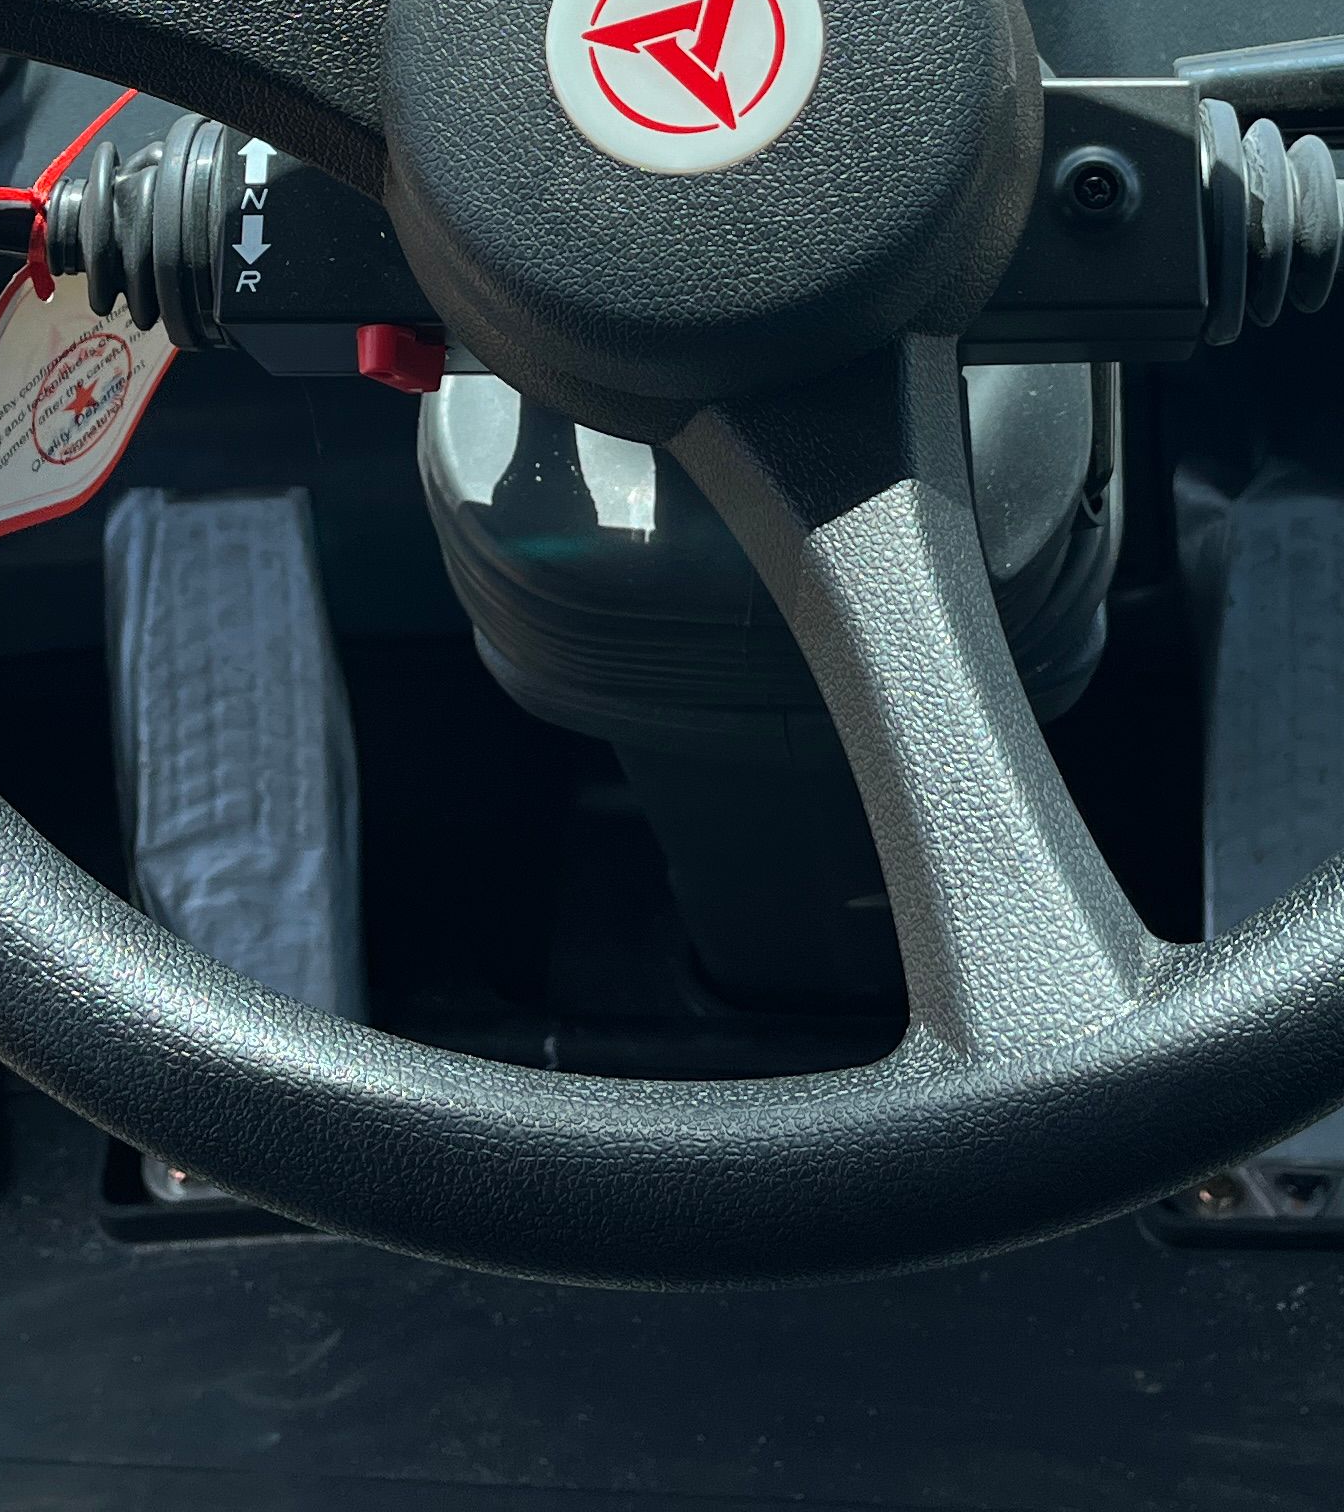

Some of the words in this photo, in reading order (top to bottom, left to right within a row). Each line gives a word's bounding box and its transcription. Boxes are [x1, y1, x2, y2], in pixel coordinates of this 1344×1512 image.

[240, 188, 269, 210] N
[235, 270, 262, 293] R
[4, 410, 27, 437] and
